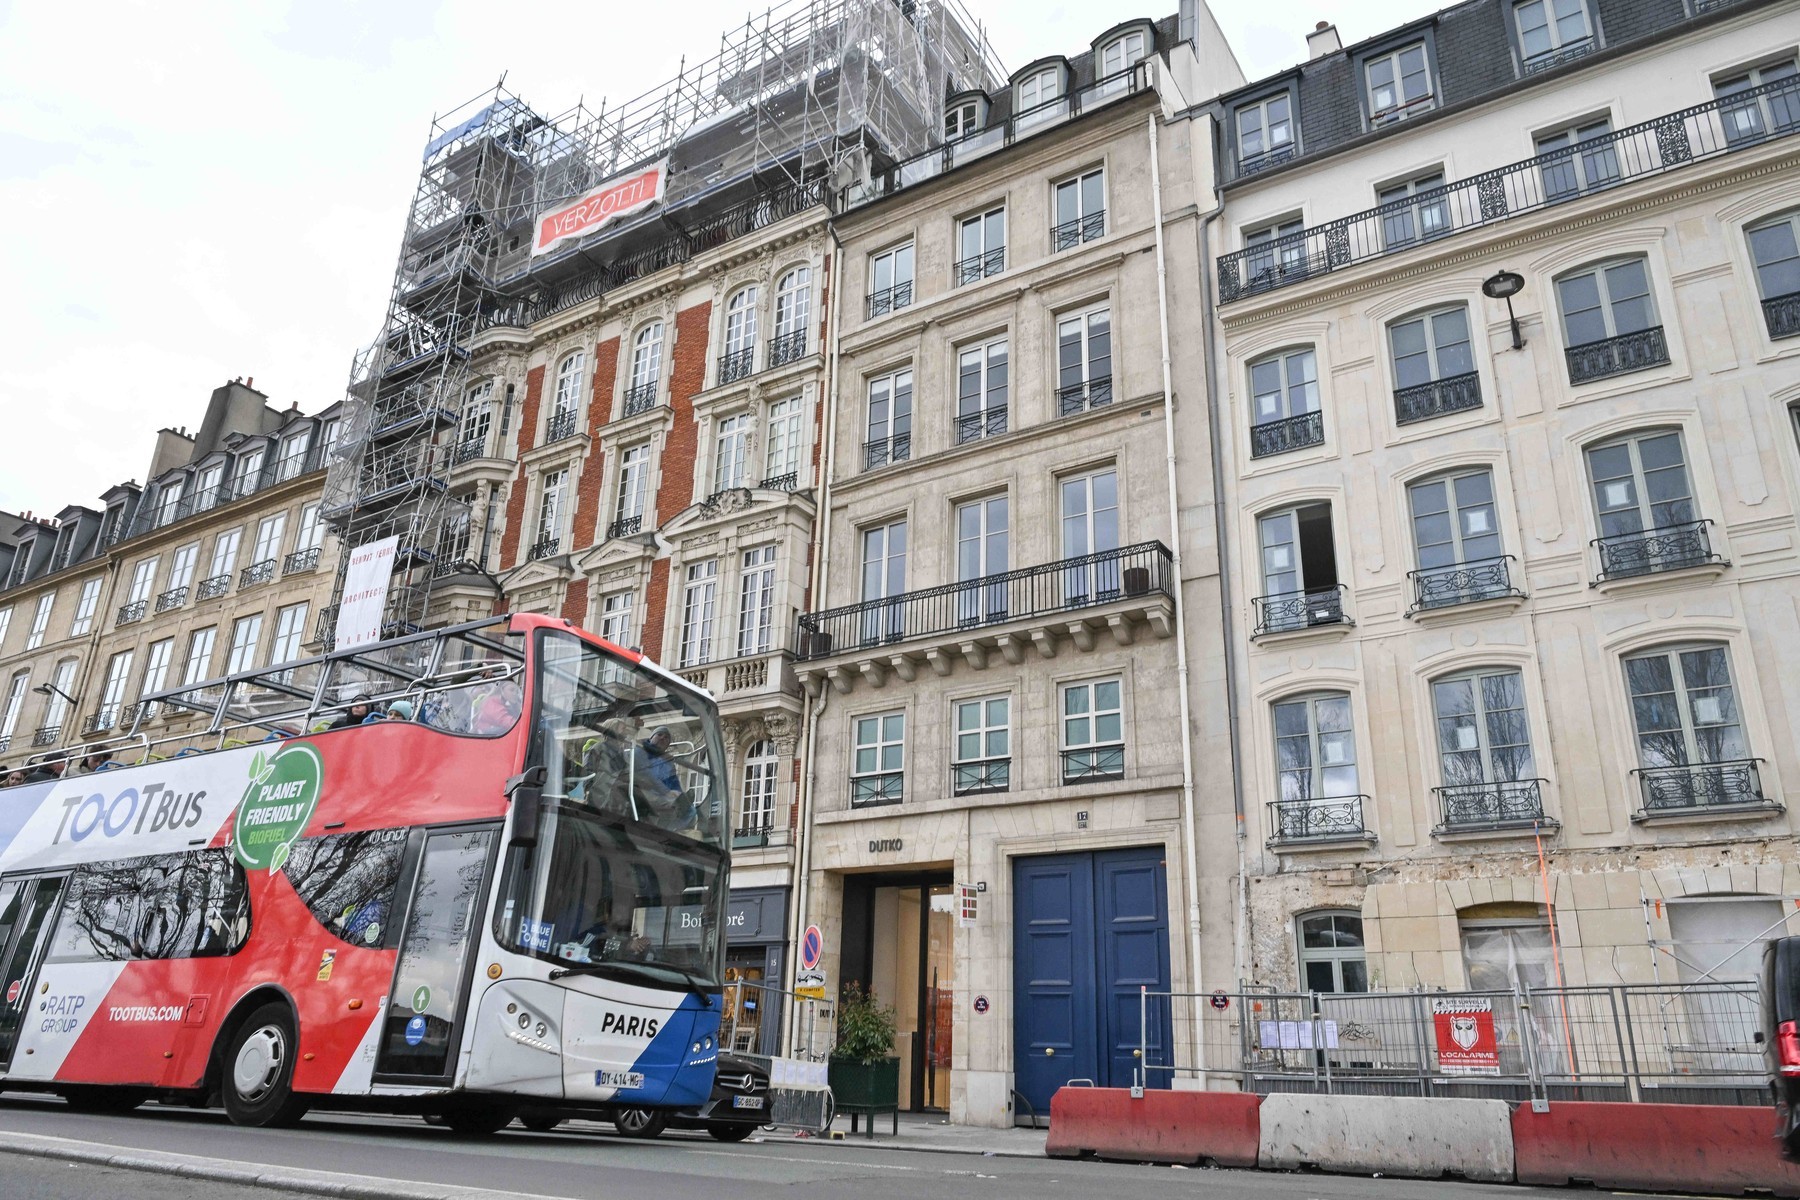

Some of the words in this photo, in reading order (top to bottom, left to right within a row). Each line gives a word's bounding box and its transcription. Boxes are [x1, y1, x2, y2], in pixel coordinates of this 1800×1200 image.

[553, 179, 645, 235] VERZOTTI
[258, 780, 306, 802] PLANET
[244, 803, 305, 826] FRIENDLY
[248, 828, 286, 845] BIOFUEL
[869, 838, 903, 853] DUTKO
[771, 958, 777, 967] 15
[45, 996, 85, 1015] RATP
[108, 1006, 184, 1021] TOOTBUS.COM
[820, 1009, 835, 1019] DUTO
[41, 1019, 78, 1034] GROUP
[601, 1012, 659, 1038] PARIS
[1441, 1051, 1495, 1059] LOCALARME
